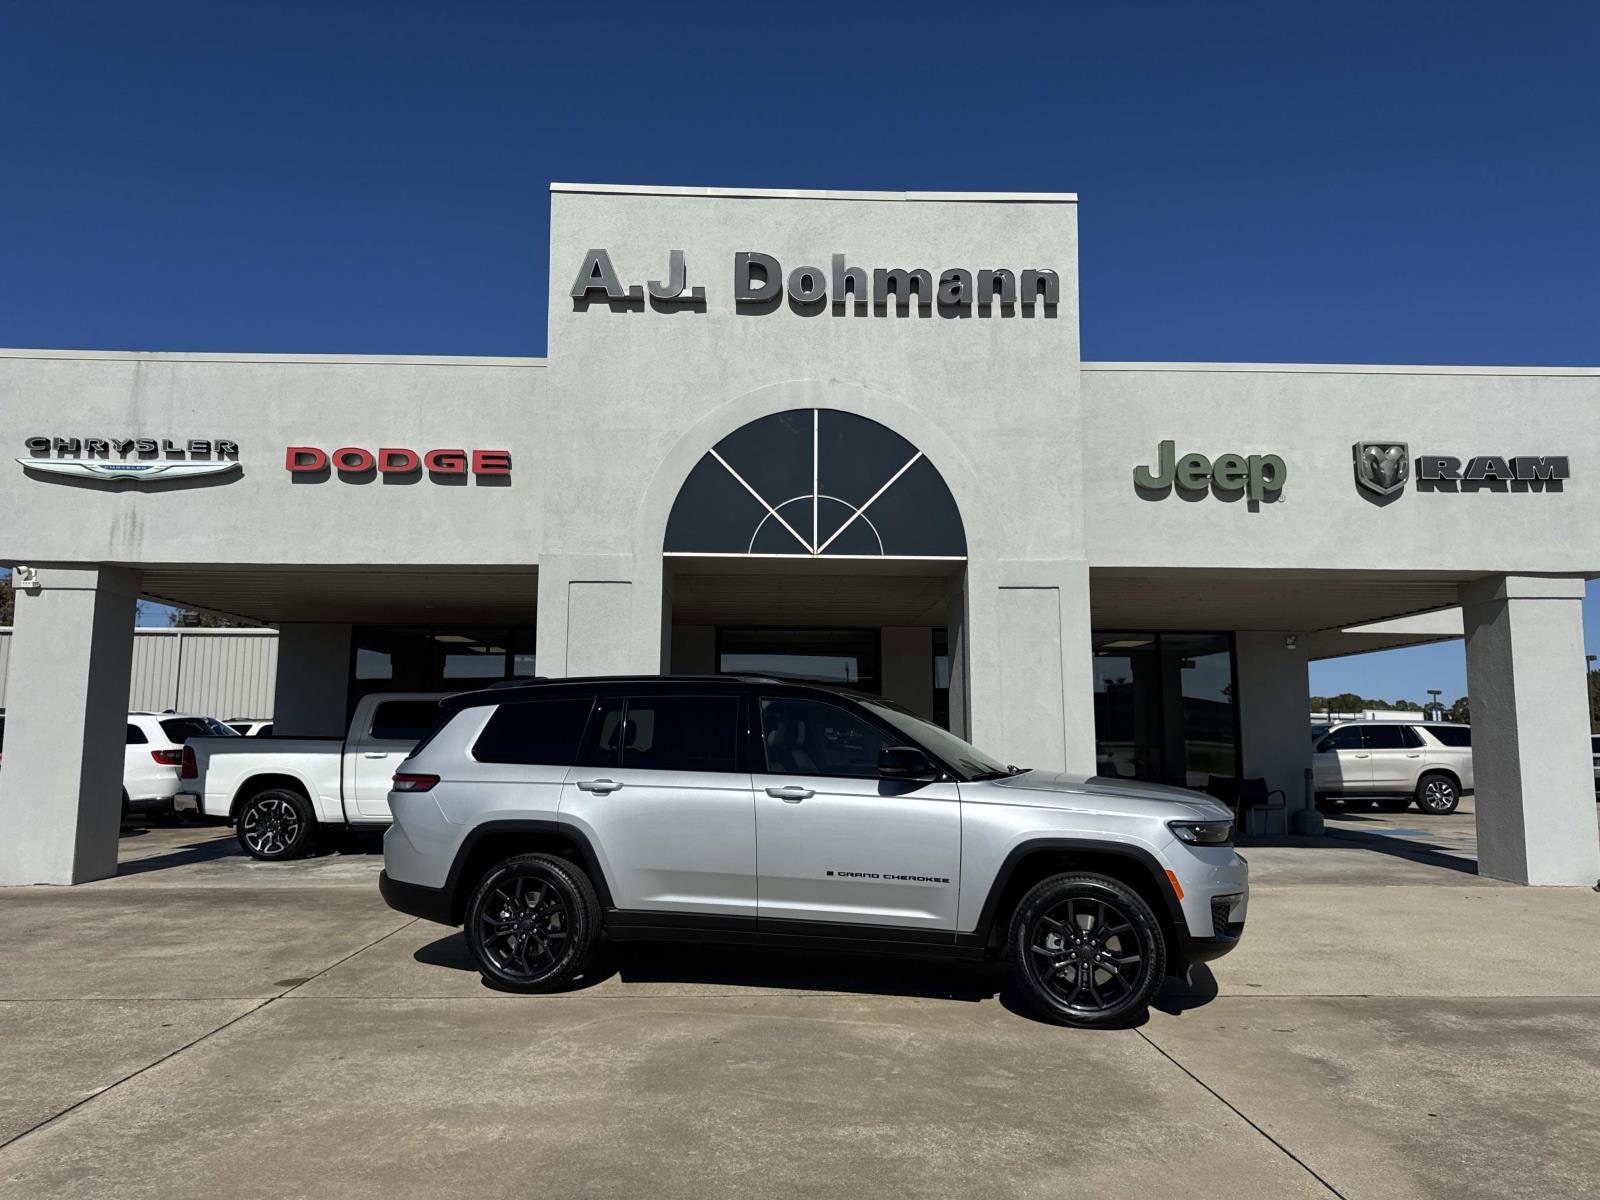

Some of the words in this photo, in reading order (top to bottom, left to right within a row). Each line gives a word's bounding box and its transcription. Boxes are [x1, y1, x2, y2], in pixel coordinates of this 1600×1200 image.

[570, 248, 705, 301] A.J.
[734, 251, 1061, 305] Dohmann
[23, 437, 239, 456] CHRYSLER
[286, 446, 511, 474] DODGE
[1133, 440, 1287, 500] Jeep
[1417, 455, 1570, 480] RAM
[837, 871, 879, 879] GRAND
[883, 874, 950, 884] CHEROKEE
